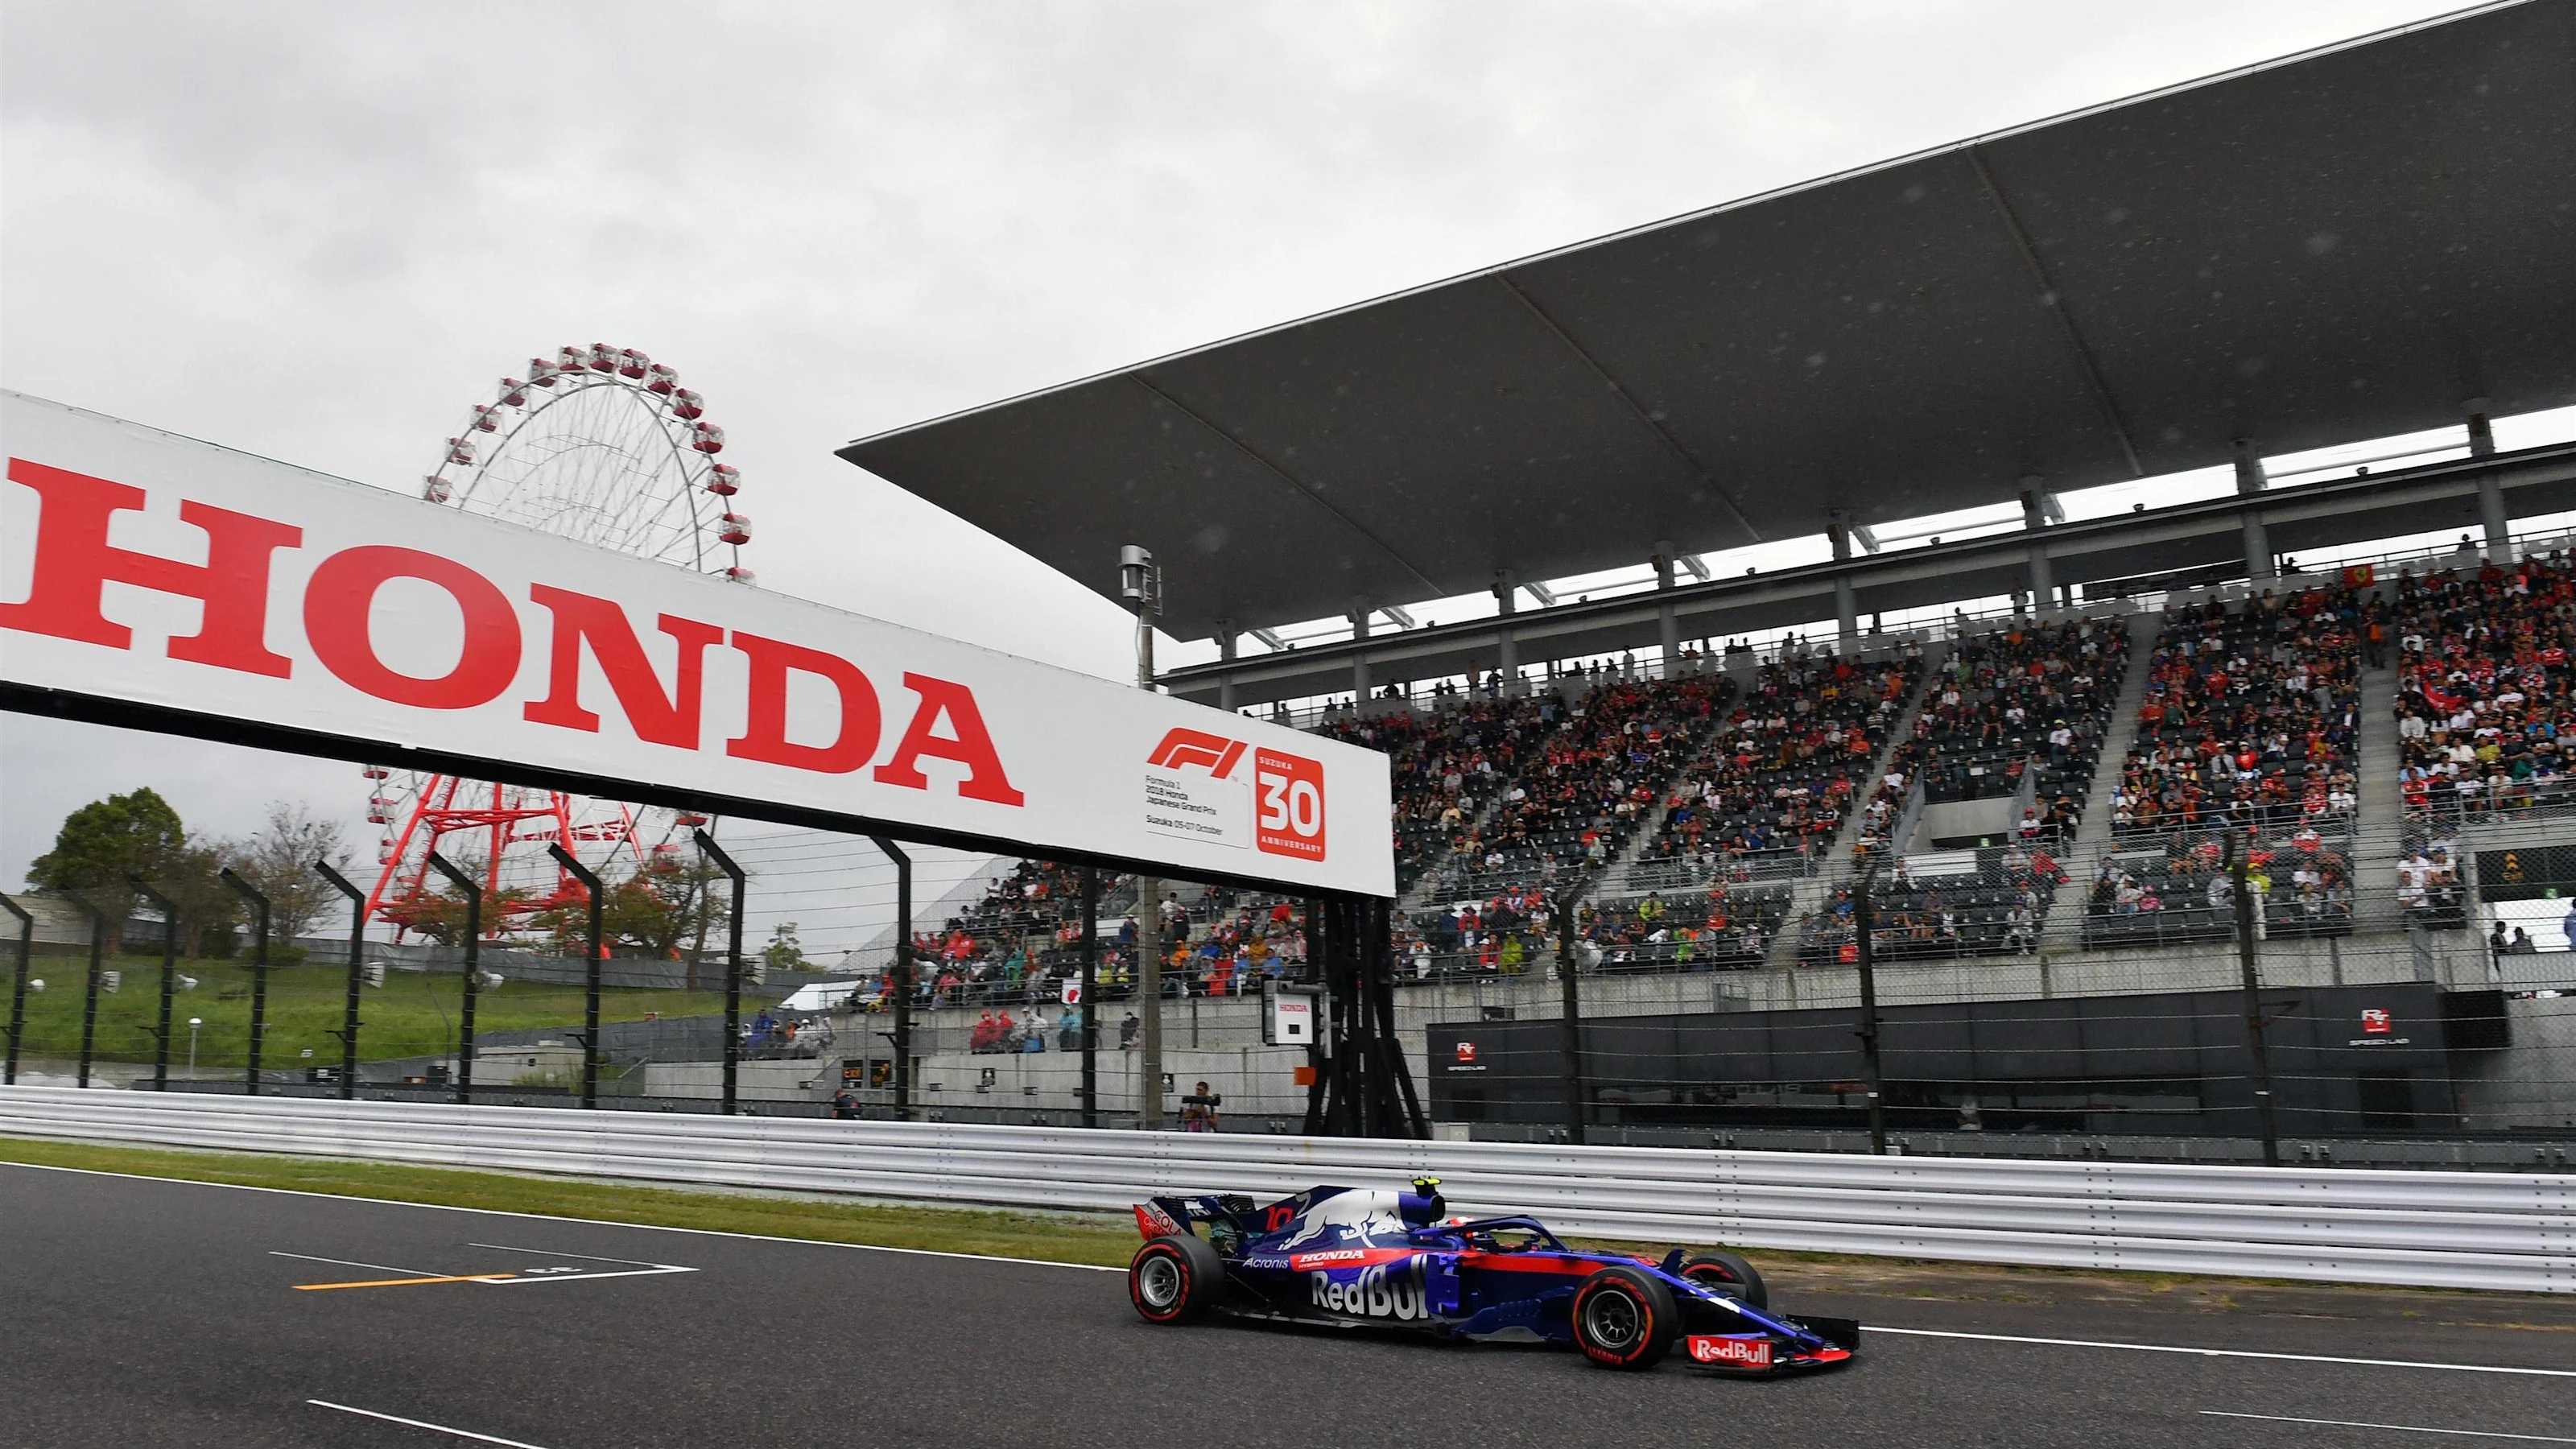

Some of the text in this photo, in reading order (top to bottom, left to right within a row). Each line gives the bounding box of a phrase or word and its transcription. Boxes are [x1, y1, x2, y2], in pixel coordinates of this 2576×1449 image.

[0, 456, 1026, 807] HONDA
[1258, 756, 1293, 770] SUZUKA
[1146, 774, 1175, 789] Formula
[1146, 785, 1189, 801] 2018 Honda
[1146, 795, 1218, 815] Japanese Grand Prix
[1258, 770, 1322, 837] 30
[1146, 815, 1173, 828] Suzuka
[1195, 824, 1223, 836] October
[1261, 835, 1323, 853] ANNIVERSARY
[1278, 1004, 1309, 1013] HONDA
[1154, 1209, 1183, 1236] COLA
[1265, 1206, 1294, 1232] 10
[1242, 1257, 1289, 1269] Acronis
[1298, 1249, 1365, 1263] HONDA
[1696, 1339, 1769, 1364] RedBull
